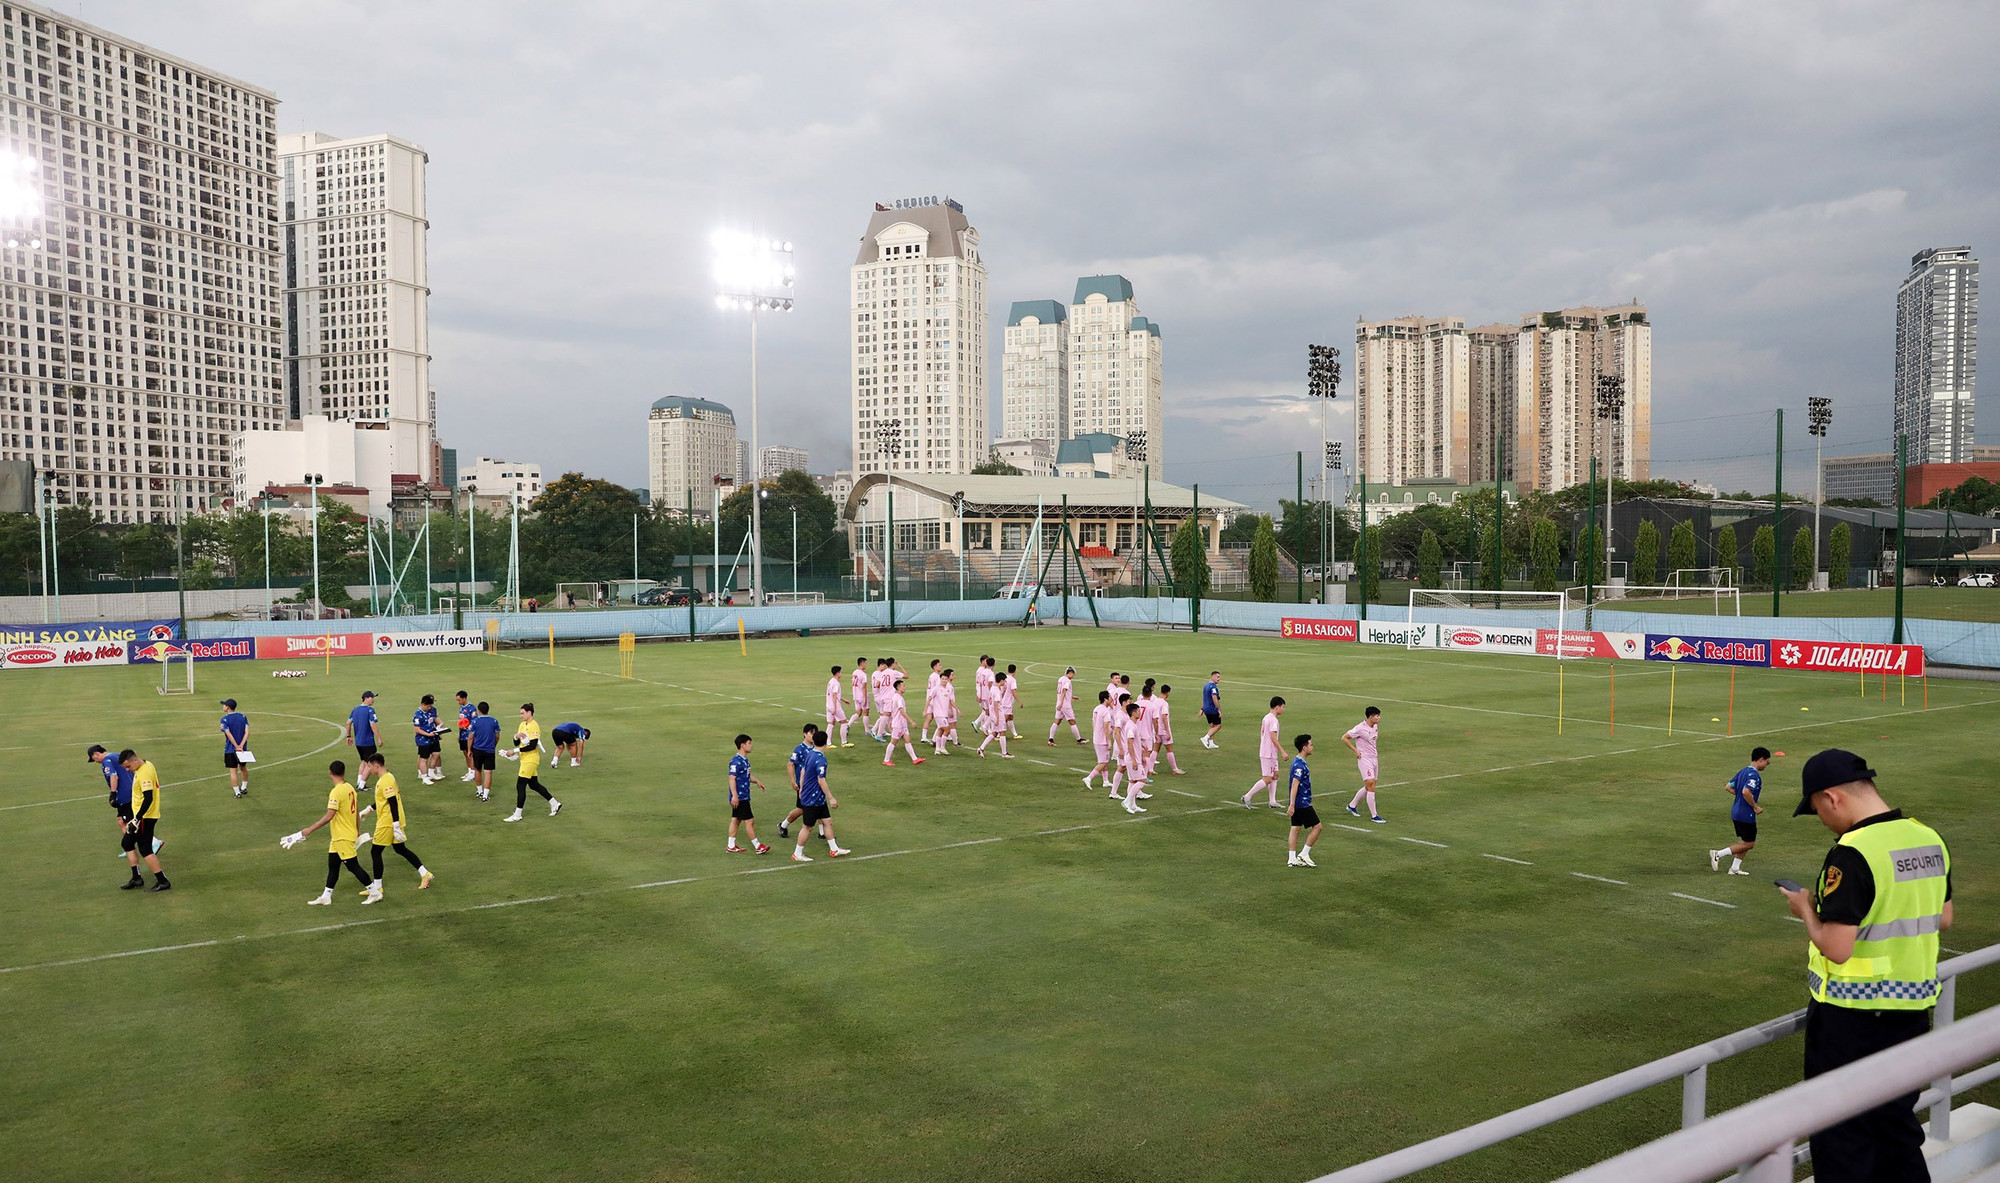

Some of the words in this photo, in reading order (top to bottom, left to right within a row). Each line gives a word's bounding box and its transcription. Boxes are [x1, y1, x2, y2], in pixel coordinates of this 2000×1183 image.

[895, 196, 938, 208] SUDICO
[39, 630, 80, 643] SAO
[83, 626, 136, 642] VÀNG
[1294, 623, 1313, 635] BIA
[396, 634, 482, 648] www.vff.org.vn
[1486, 634, 1532, 646] MODERN
[1545, 633, 1559, 641] VFF
[1561, 634, 1595, 643] CHANNEL
[191, 642, 220, 657] Red
[220, 641, 250, 656] Bull
[1704, 642, 1734, 660] Red
[1734, 643, 1766, 661] Bull
[1806, 646, 1908, 670] JOGARBOLA
